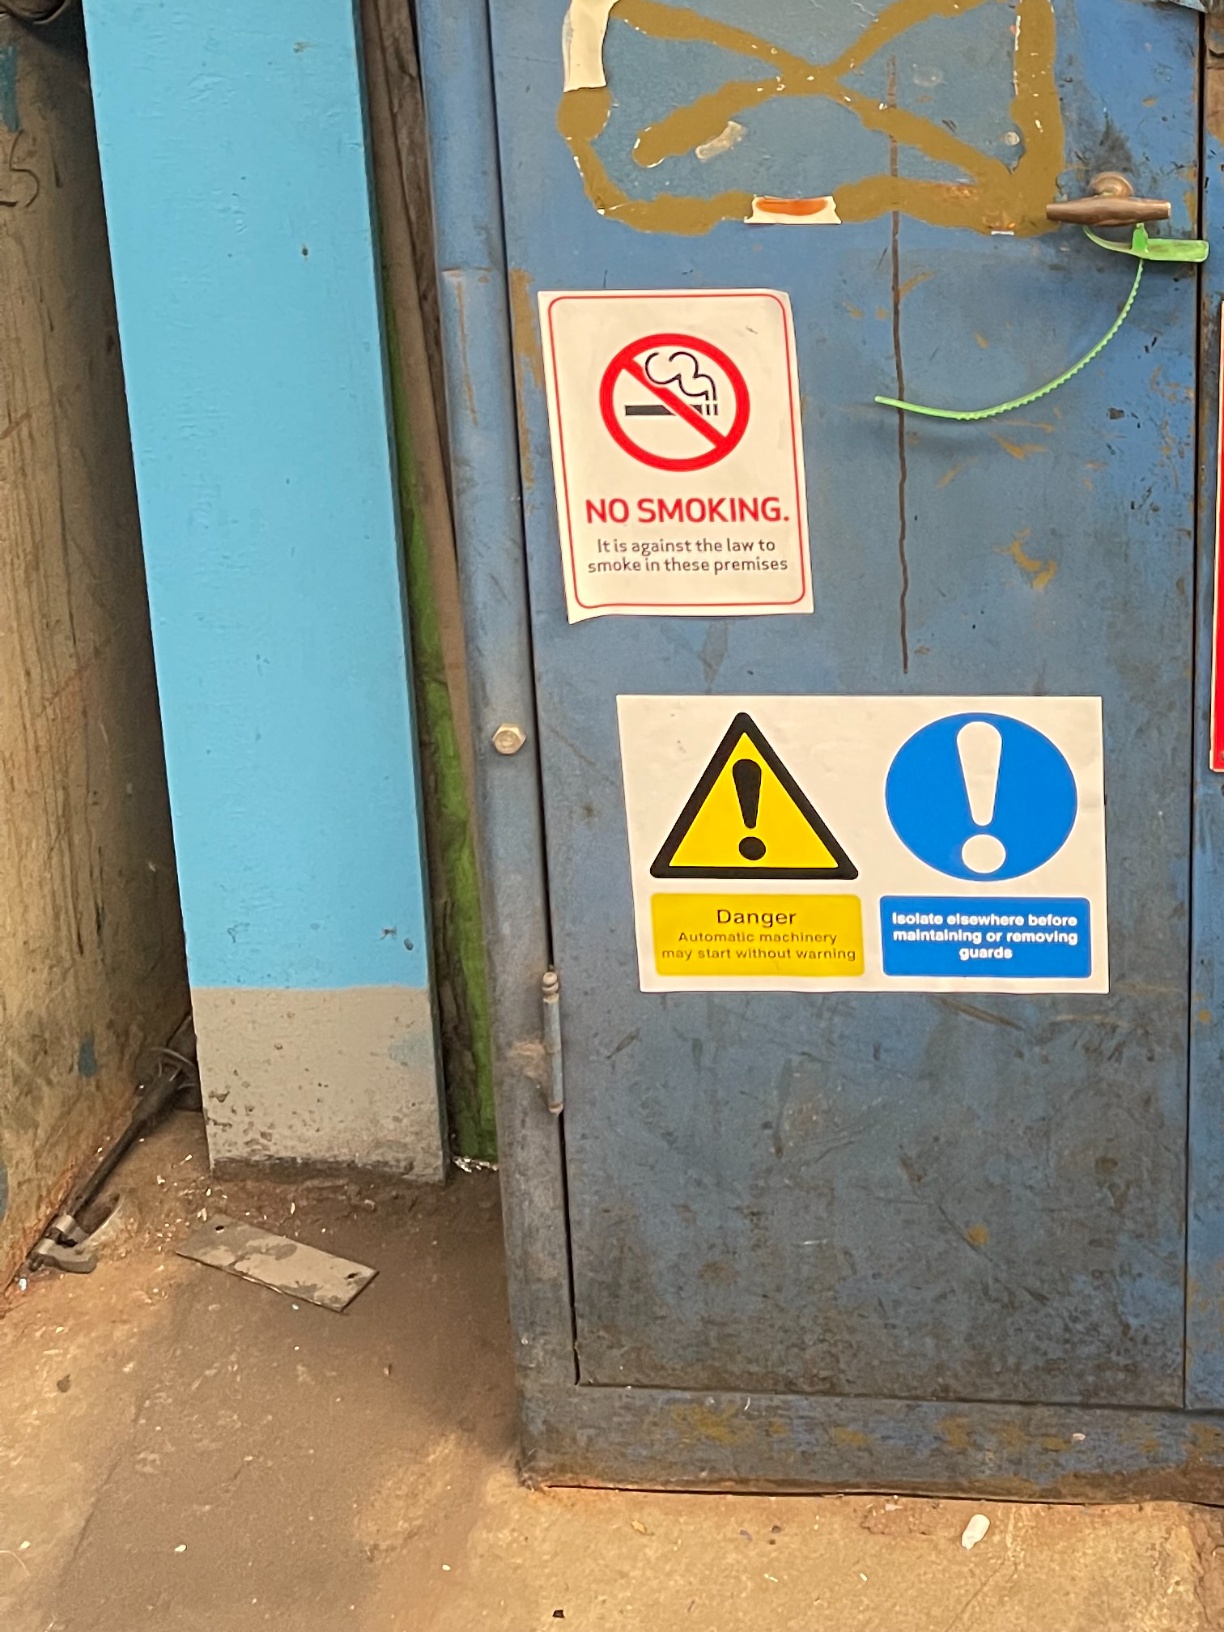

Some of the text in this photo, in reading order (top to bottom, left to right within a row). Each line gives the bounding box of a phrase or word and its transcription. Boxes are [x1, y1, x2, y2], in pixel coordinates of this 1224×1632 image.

[585, 496, 790, 524] NO SMOKING.
[597, 537, 776, 556] It is against the law to
[588, 557, 788, 575] smoke in these premises
[716, 909, 797, 928] Danger
[891, 912, 1078, 927] Isolate elsewhere before
[678, 931, 838, 946] Automatic machinery
[892, 928, 1079, 946] maintaining or removing
[661, 947, 856, 962] may start without warning
[958, 946, 1014, 961] guards
